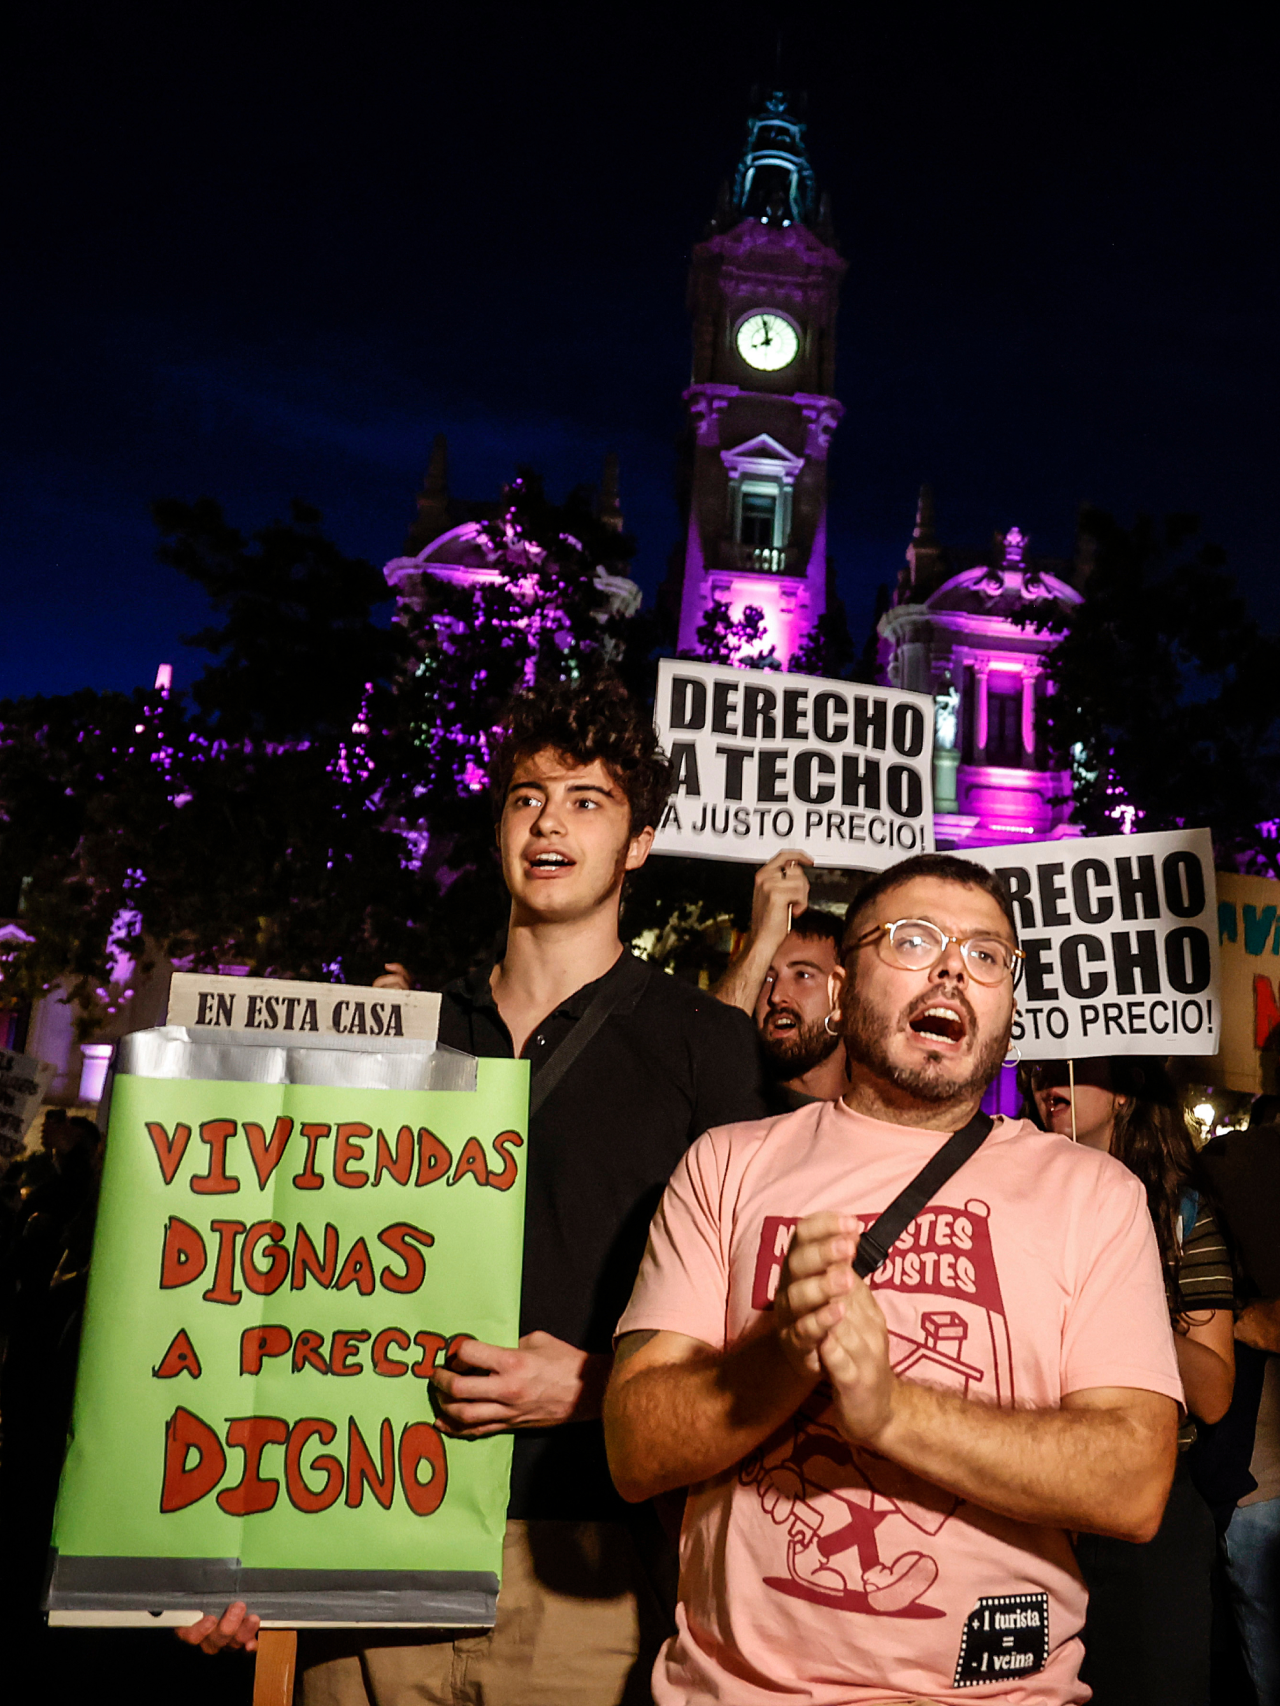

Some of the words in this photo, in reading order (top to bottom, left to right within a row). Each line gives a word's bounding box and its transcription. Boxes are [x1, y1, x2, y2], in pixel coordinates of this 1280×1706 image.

[669, 677, 924, 758] DERECHO
[672, 742, 701, 796] A
[716, 746, 923, 818] TECHO
[660, 805, 681, 829] A
[693, 804, 794, 837] JUSTO
[805, 811, 926, 851] PRECIO!
[995, 851, 1206, 929] RECHO
[1021, 926, 1211, 1002] ECHO
[195, 991, 234, 1027] EN
[246, 996, 319, 1032] ESTA
[332, 1000, 404, 1037] CASA
[1011, 1006, 1069, 1040] STO
[1080, 999, 1214, 1037] PRECIO!
[145, 1116, 524, 1195] VIVIENDAS
[159, 1215, 435, 1305] DIGNAS
[152, 1328, 202, 1379] A
[160, 1405, 448, 1516] DIGNO
[994, 1608, 1040, 1630] turista
